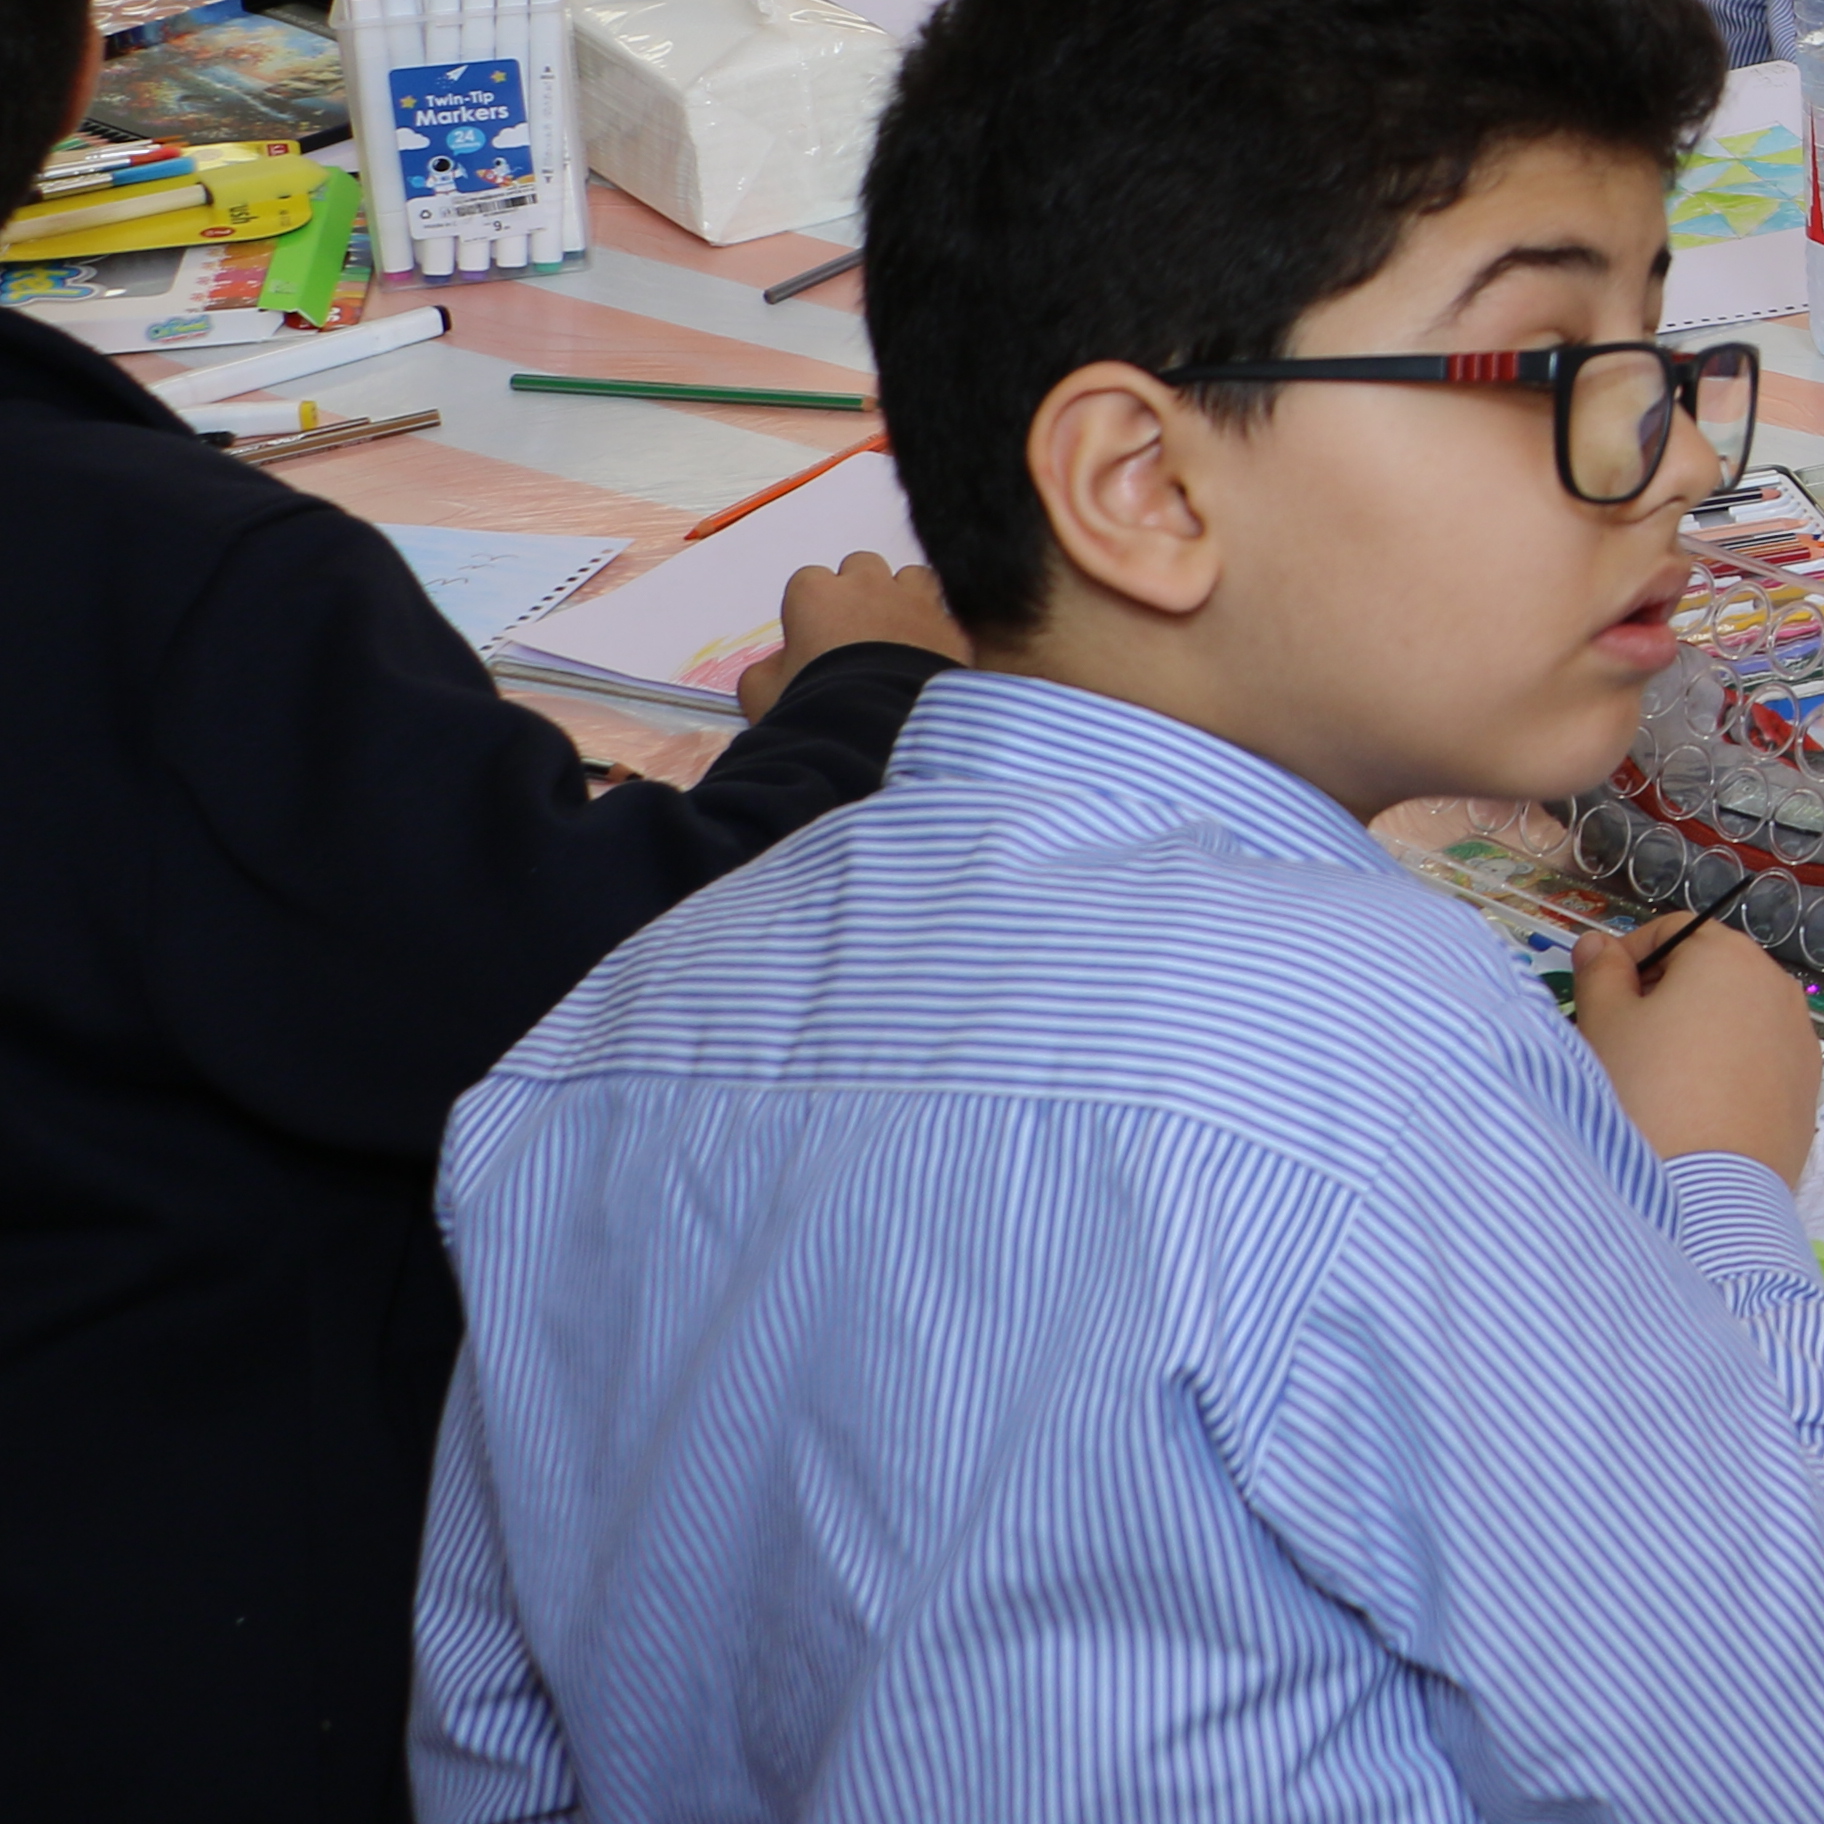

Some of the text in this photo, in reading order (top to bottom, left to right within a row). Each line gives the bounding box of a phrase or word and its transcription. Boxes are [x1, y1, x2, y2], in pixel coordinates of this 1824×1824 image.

[425, 91, 495, 108] Twin-Tip
[415, 106, 510, 127] Markers
[453, 130, 476, 143] 24
